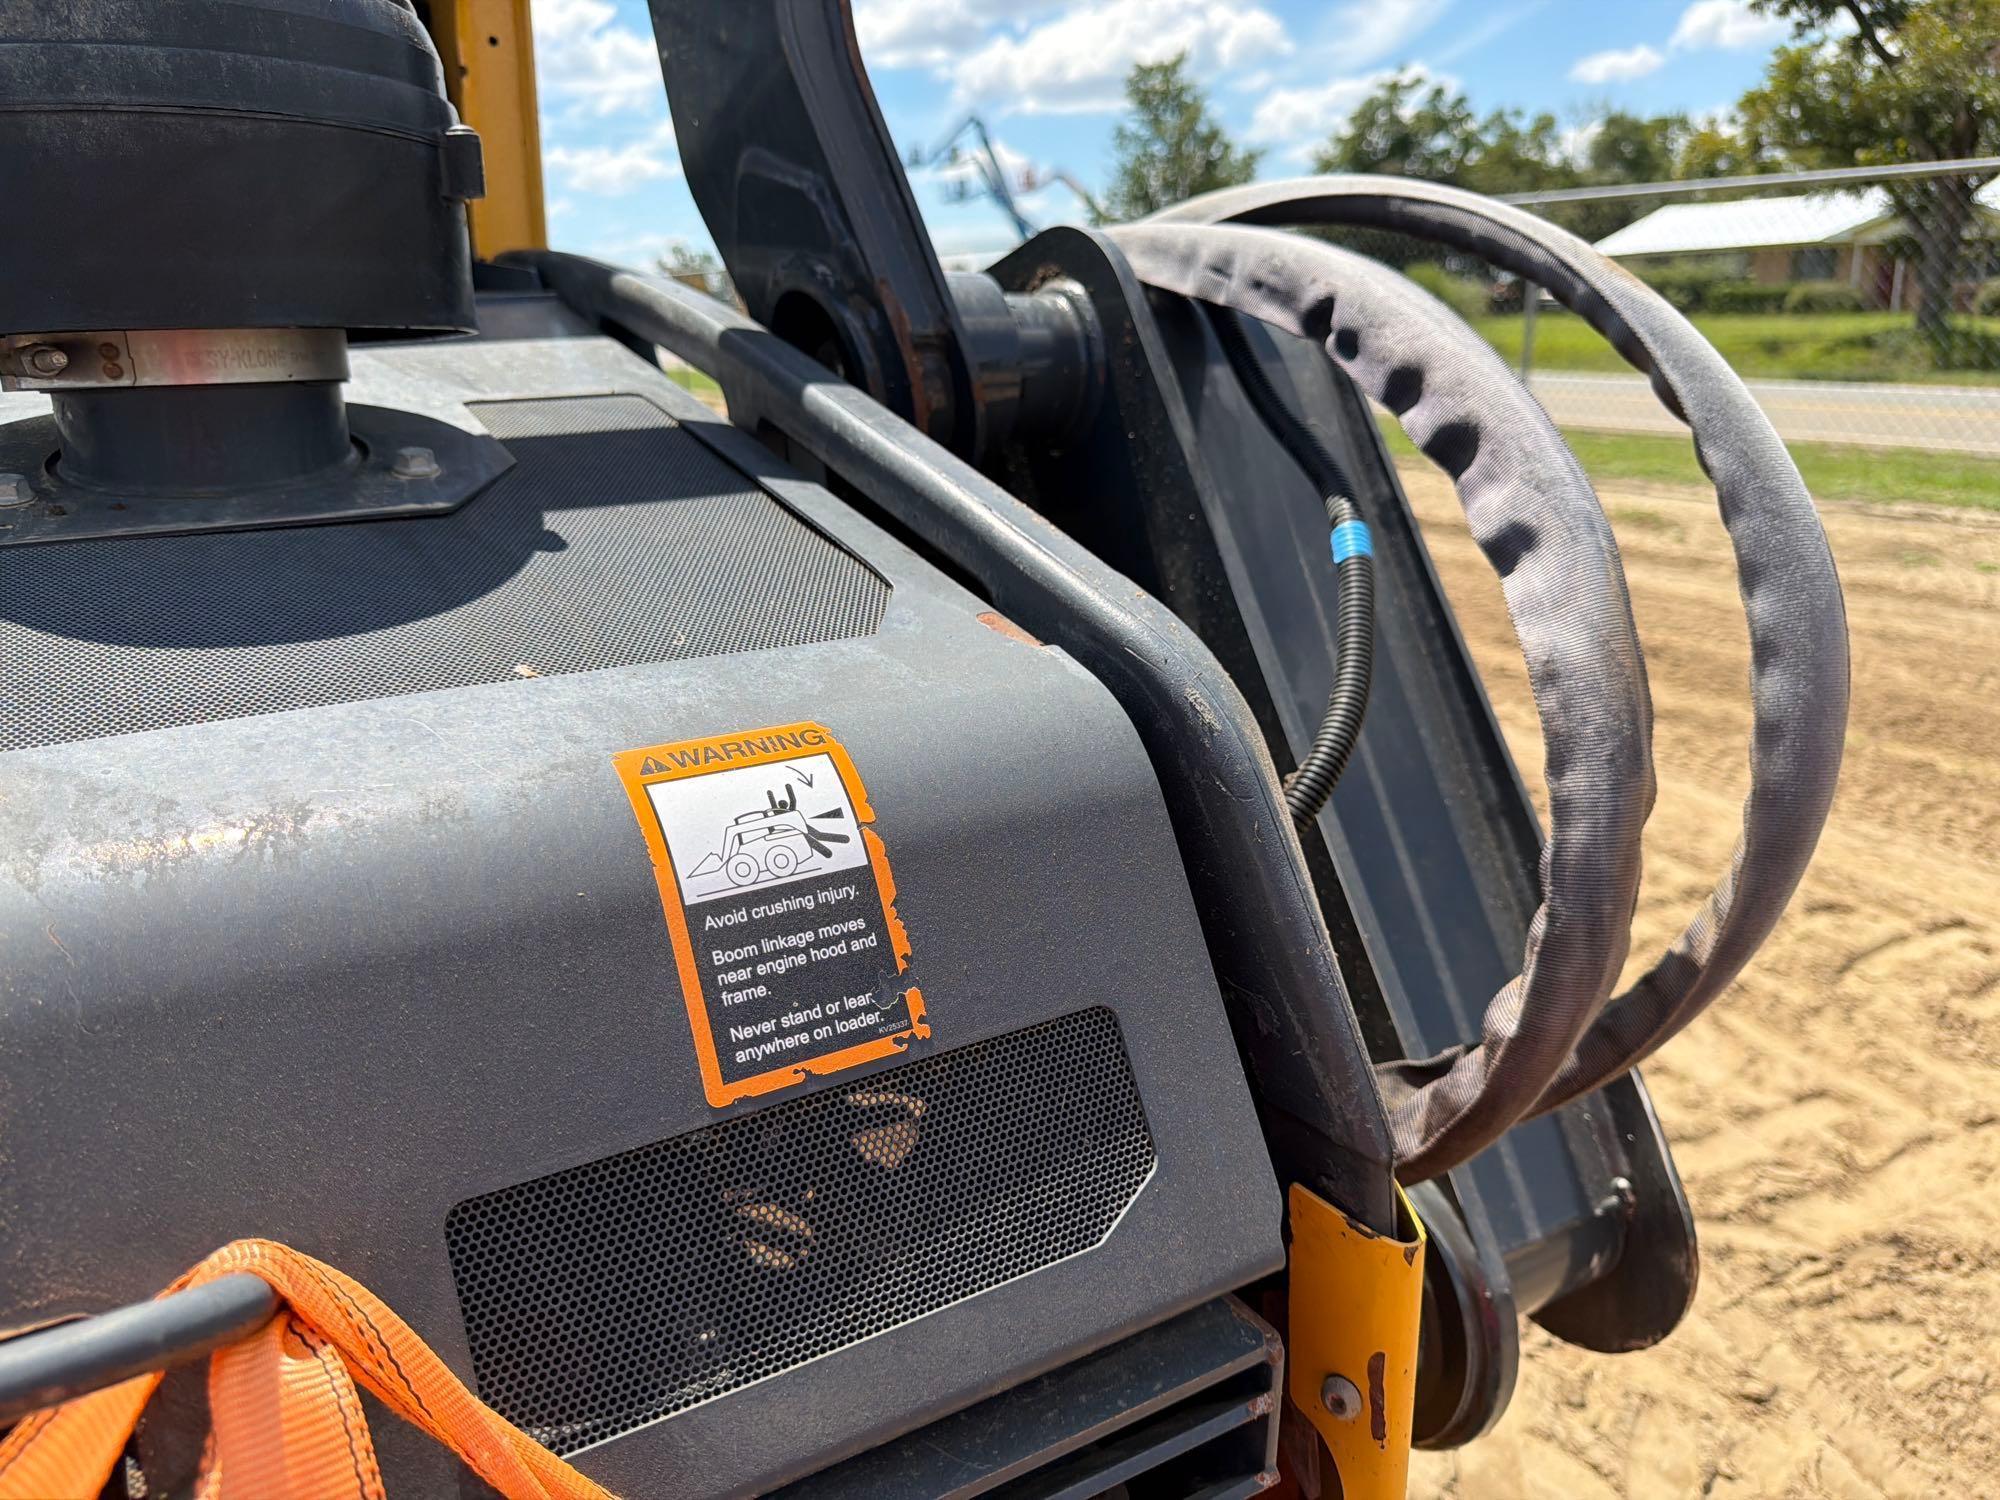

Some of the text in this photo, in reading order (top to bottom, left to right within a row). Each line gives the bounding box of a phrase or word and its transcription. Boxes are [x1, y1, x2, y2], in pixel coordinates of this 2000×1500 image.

[667, 729, 826, 768] WARNING
[704, 885, 859, 931] Avoid crushing injury.
[712, 917, 866, 965] Boom linkage moves
[717, 933, 877, 986] near engine hood and
[721, 985, 771, 1007] frame.
[730, 1018, 776, 1042] Never
[781, 1005, 823, 1027] stand
[825, 1000, 841, 1015] or
[735, 1011, 884, 1063] anywhere on loader.
